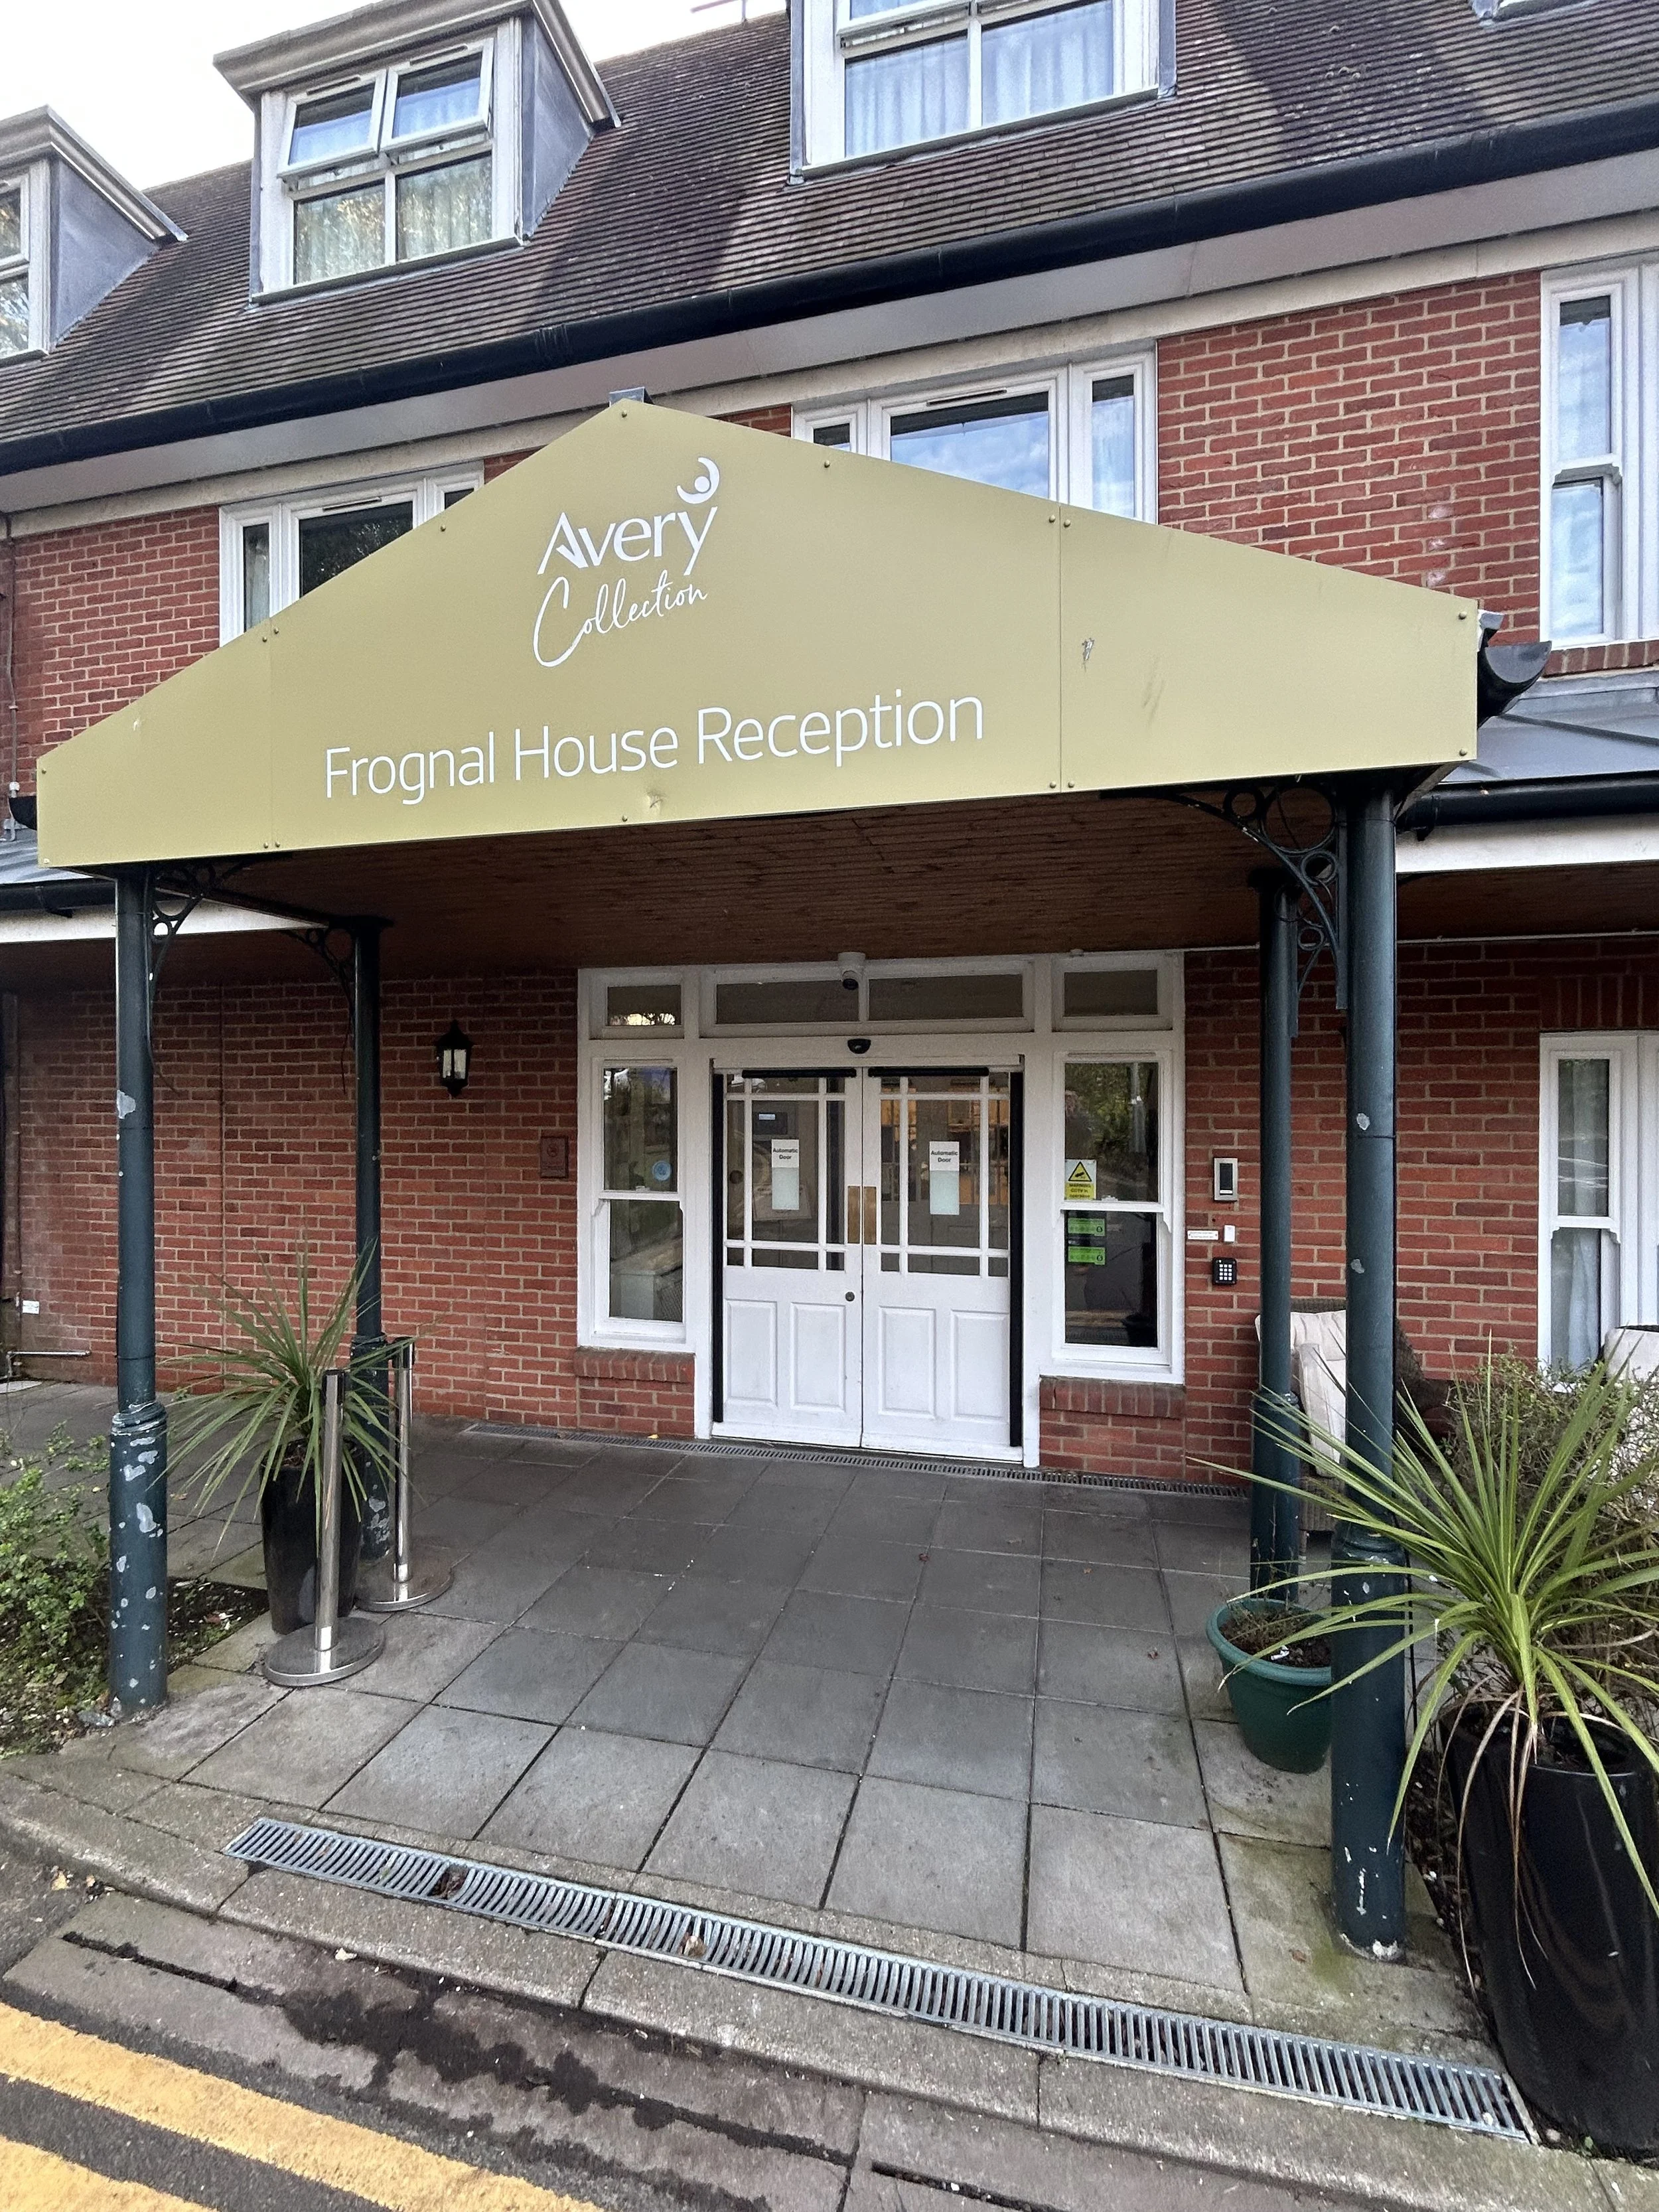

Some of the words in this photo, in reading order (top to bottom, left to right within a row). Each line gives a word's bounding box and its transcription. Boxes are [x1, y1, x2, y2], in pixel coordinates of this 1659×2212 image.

[537, 506, 718, 576] Avery
[533, 568, 709, 668] Collection
[326, 731, 494, 805] Frognal
[515, 725, 678, 781] House
[697, 688, 983, 767] Reception
